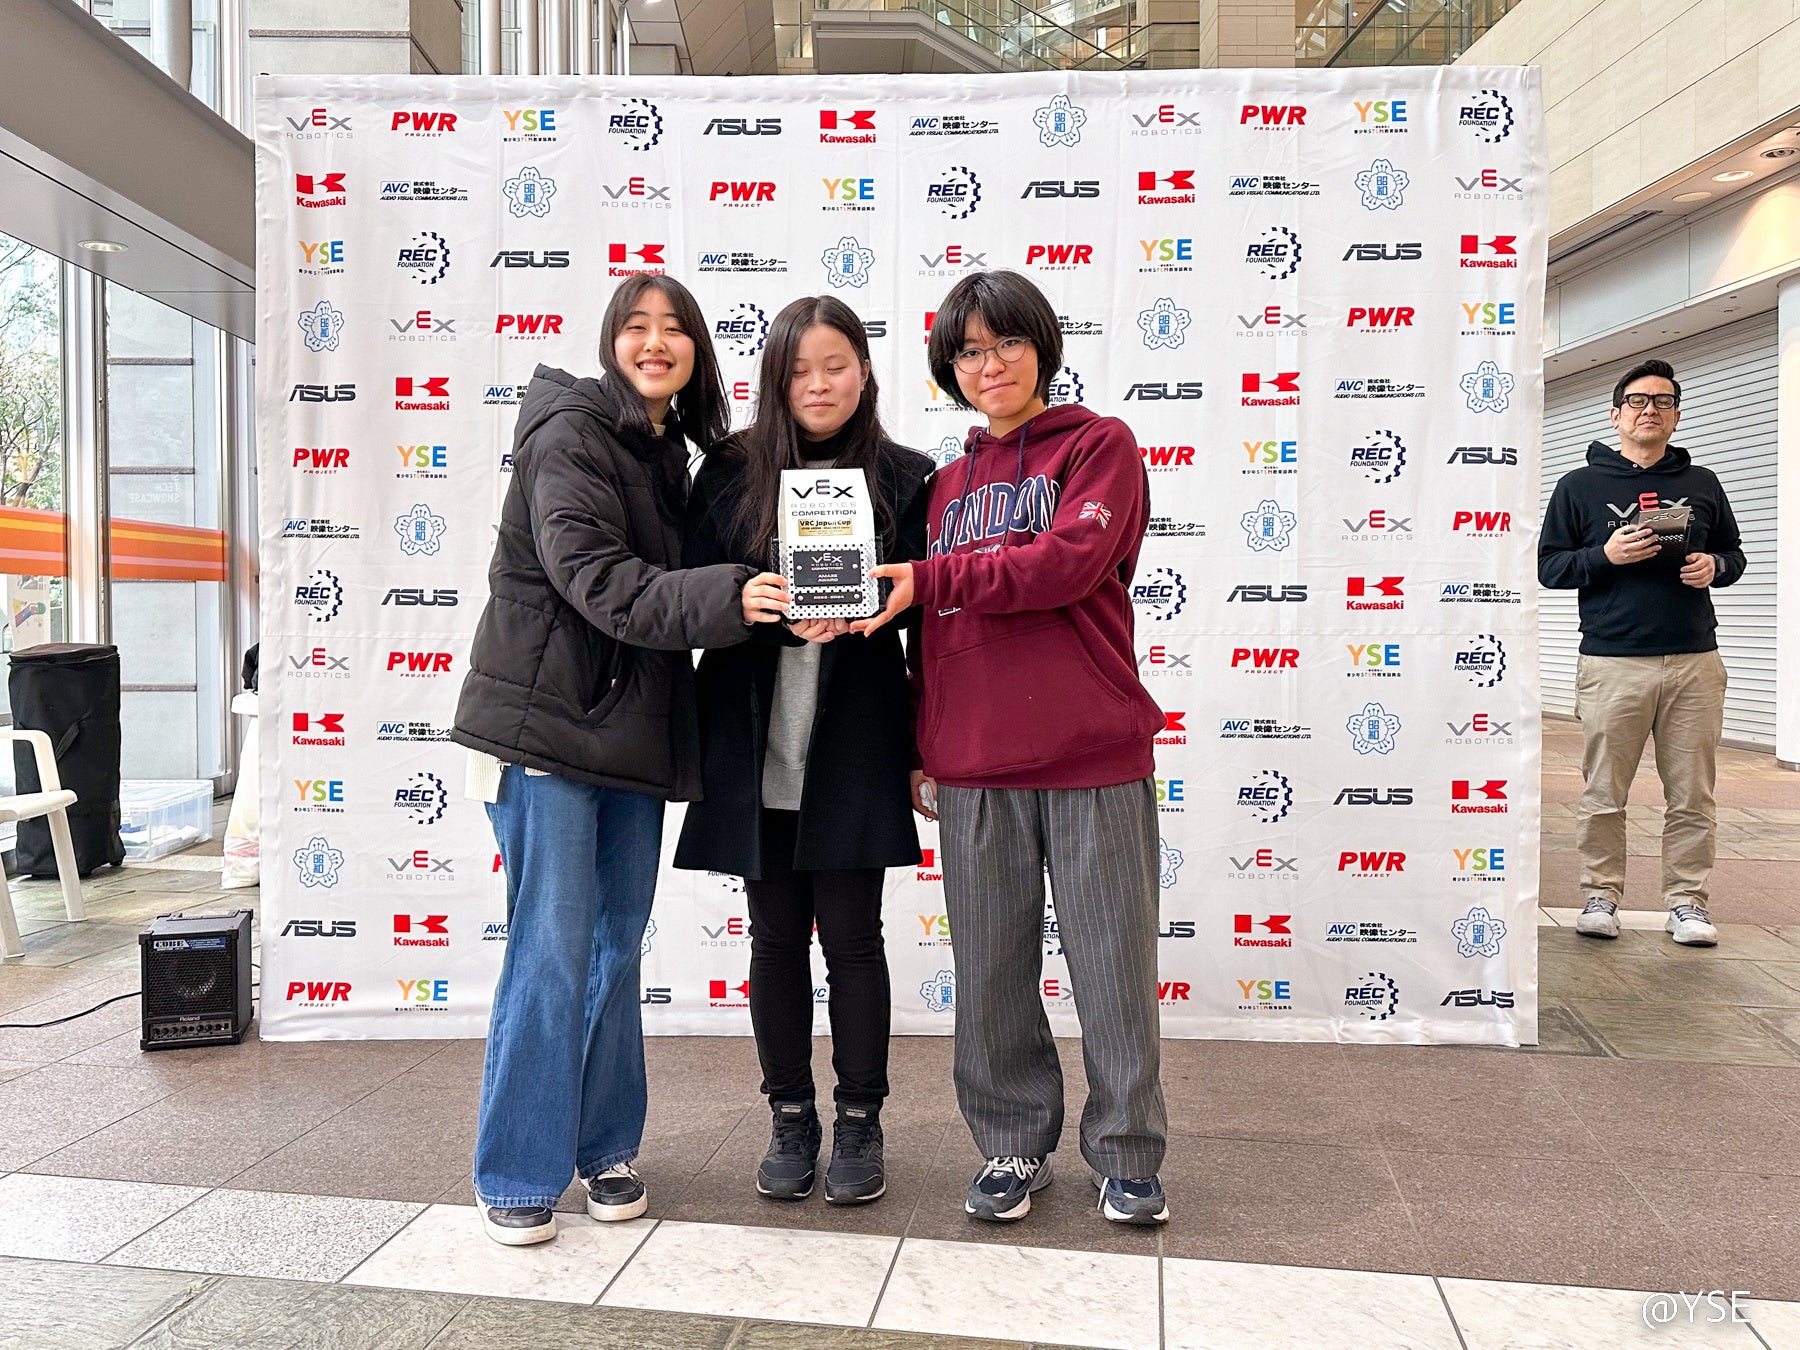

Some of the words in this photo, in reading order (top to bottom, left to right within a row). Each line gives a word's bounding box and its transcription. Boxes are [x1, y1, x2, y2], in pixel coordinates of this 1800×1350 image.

[286, 108, 352, 131] VEX
[503, 110, 556, 131] YSE
[1132, 105, 1200, 127] VEX
[1240, 105, 1307, 125] PWR
[1354, 101, 1407, 123] YSE
[1460, 106, 1499, 118] REC
[391, 112, 457, 132] PWR
[609, 115, 649, 128] REC
[703, 118, 782, 135] ASUS
[912, 118, 938, 128] AVC
[943, 121, 998, 129] 映像センター
[820, 133, 876, 143] Kawasaki
[383, 183, 410, 193] AVC
[602, 177, 670, 200] VEX
[823, 178, 874, 200] YSE
[1233, 178, 1259, 187] AVC
[1263, 181, 1319, 190] 映像センター
[1455, 169, 1523, 192] VEX
[709, 182, 776, 201] PWR
[928, 184, 967, 197] REC
[1020, 181, 1100, 199] ASUS
[296, 196, 346, 208] Kawasaki
[601, 201, 671, 209] ROBOTICS
[1138, 194, 1195, 205] Kawasaki
[299, 241, 344, 264] YSE
[399, 249, 437, 261] REC
[920, 245, 987, 269] VEX
[1026, 244, 1093, 265] PWR
[1140, 239, 1192, 261] YSE
[1248, 244, 1288, 256] REC
[1342, 243, 1422, 261] ASUS
[490, 251, 569, 268] ASUS
[701, 254, 727, 264] AVC
[731, 258, 786, 266] 映像センター
[1460, 258, 1517, 268] Kawasaki
[390, 310, 456, 333] VEX
[1237, 306, 1307, 329] VEX
[1347, 307, 1415, 327] PWR
[1462, 302, 1515, 324] YSE
[495, 314, 563, 334] PWR
[716, 321, 755, 332] REC
[389, 334, 456, 342] ROBOTICS
[289, 384, 355, 402] ASUS
[486, 387, 513, 397] AVC
[1123, 382, 1203, 401] ASUS
[1337, 381, 1363, 391] AVC
[1368, 384, 1424, 393] 映像センター
[395, 401, 450, 410] Kawasaki
[1241, 396, 1300, 406] Kawasaki
[293, 448, 350, 468] PWR
[397, 445, 447, 467] YSE
[1243, 441, 1297, 463] YSE
[1351, 447, 1392, 459] REC
[1447, 447, 1517, 465] ASUS
[791, 479, 854, 498] VEX
[285, 521, 306, 530] AVC
[927, 475, 1061, 559] LONDON
[1343, 510, 1412, 532] VEX
[1452, 511, 1511, 532] PWR
[311, 525, 359, 533] 映像センター
[1342, 533, 1413, 541] ROBOTICS
[811, 553, 842, 563] VEX
[296, 587, 330, 598] REC
[381, 589, 458, 606] ASUS
[1133, 585, 1172, 597] REC
[1226, 585, 1307, 602] ASUS
[1443, 584, 1468, 594] AVC
[1473, 589, 1520, 597] 映像センター
[1347, 600, 1404, 610] Kawasaki
[289, 648, 350, 670] VEX
[387, 652, 452, 672] PWR
[1231, 648, 1300, 668] PWR
[1347, 644, 1400, 666] YSE
[1456, 653, 1495, 664] REC
[380, 723, 405, 733] AVC
[1223, 721, 1249, 730] AVC
[1447, 713, 1512, 736] VEX
[293, 736, 345, 746] Kawasaki
[295, 780, 343, 802] YSE
[396, 790, 433, 801] REC
[1239, 787, 1279, 799] REC
[1333, 788, 1413, 806] ASUS
[1452, 804, 1508, 813] Kawasaki
[388, 850, 454, 872] VEX
[1229, 849, 1298, 871] VEX
[1338, 852, 1406, 871] PWR
[1453, 848, 1504, 870] YSE
[387, 873, 454, 881] ROBOTICS
[280, 920, 356, 937] ASUS
[918, 915, 950, 936] YS
[1329, 924, 1355, 934] AVC
[1360, 928, 1416, 937] 映像センター
[394, 937, 449, 947] Kawasaki
[1234, 937, 1291, 947] Kawasaki
[286, 982, 352, 1001] PWR
[397, 980, 448, 1001] YSE
[1237, 980, 1290, 1000] YSE
[1346, 987, 1385, 999] REC
[1440, 988, 1515, 1010] ASUS
